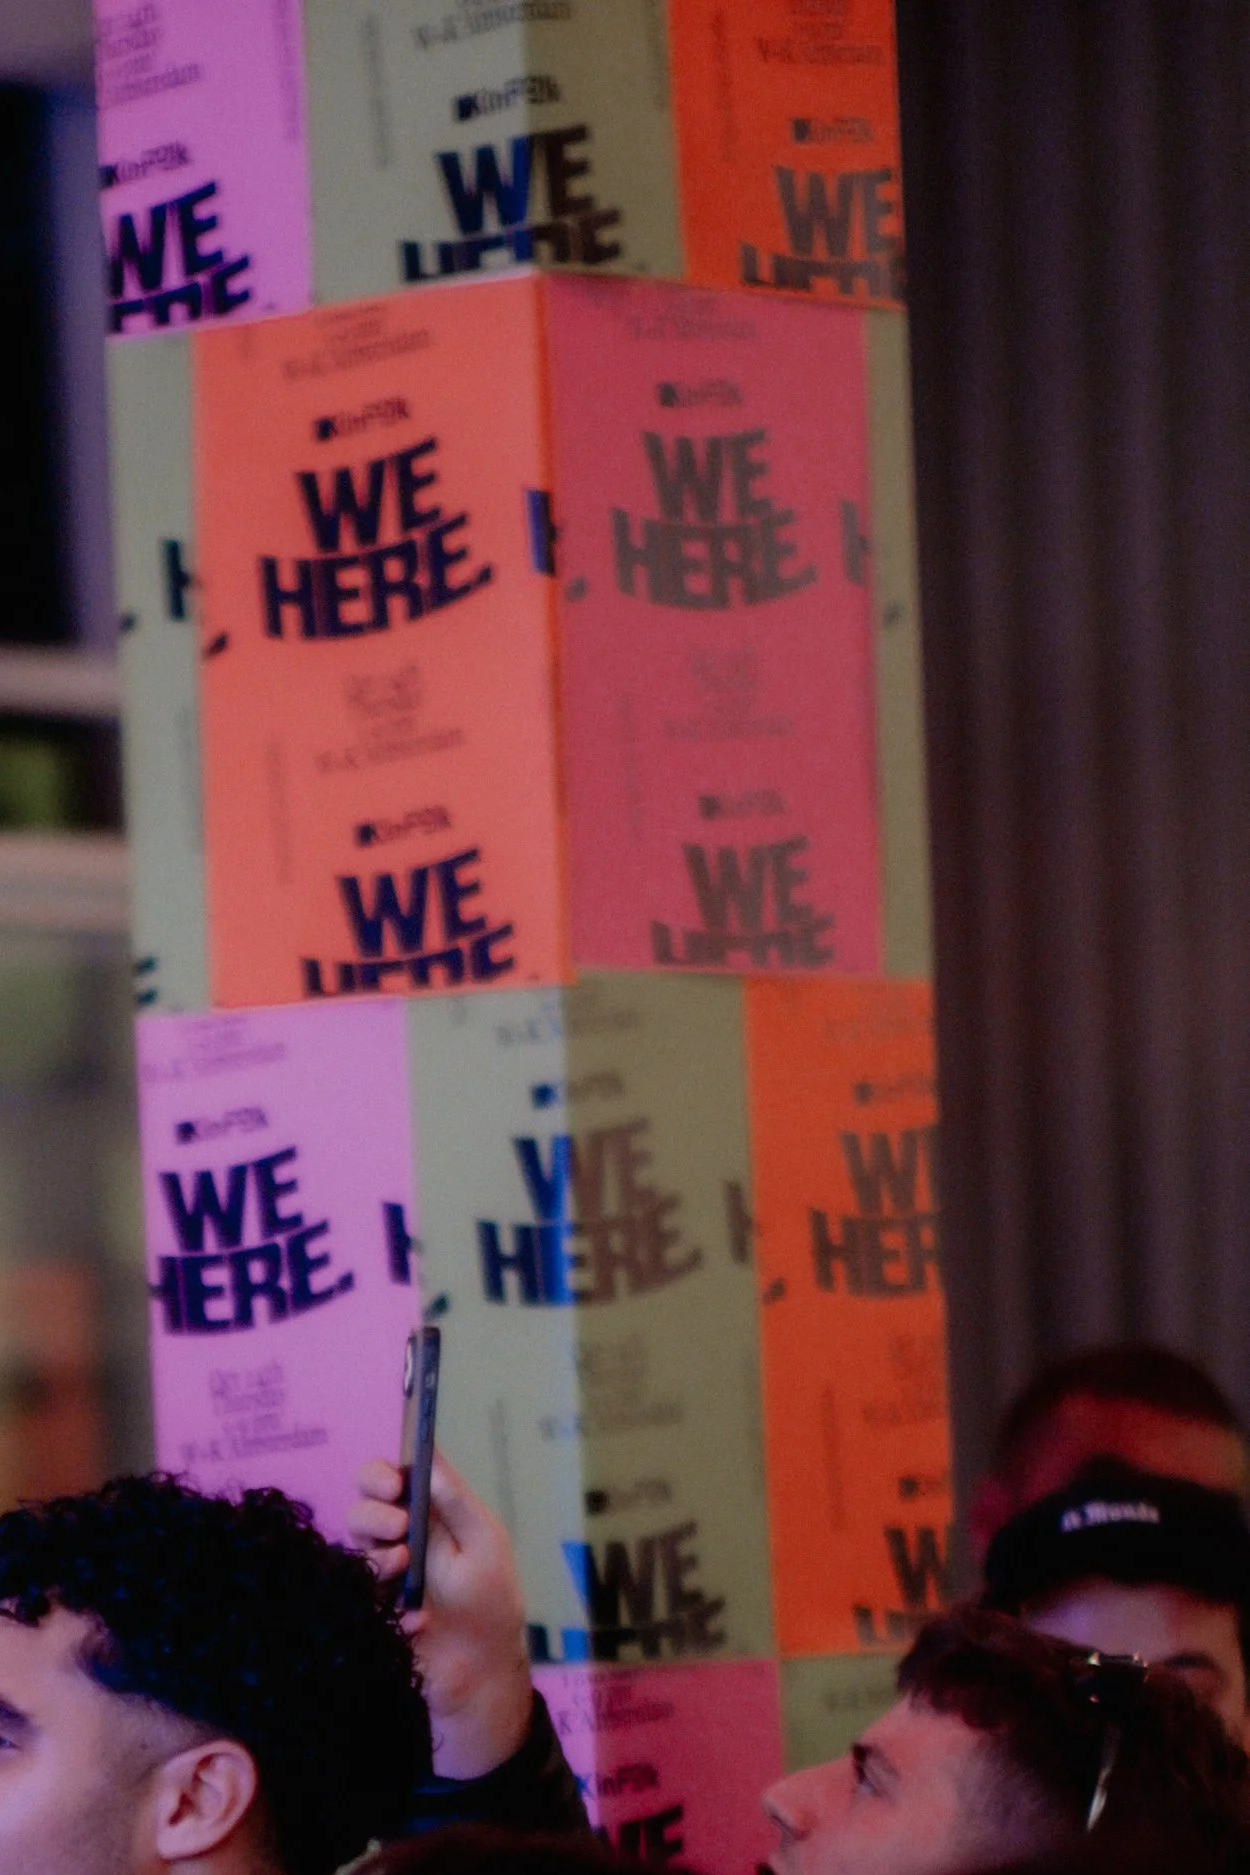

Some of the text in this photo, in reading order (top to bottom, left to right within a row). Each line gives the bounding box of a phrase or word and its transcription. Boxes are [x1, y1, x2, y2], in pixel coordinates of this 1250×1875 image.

[435, 123, 591, 236] WE
[296, 436, 443, 553] WE
[644, 427, 772, 525] WE
[336, 847, 487, 958] WE
[682, 835, 810, 940] WE
[159, 1146, 303, 1253] WE
[561, 1517, 707, 1632] WE
